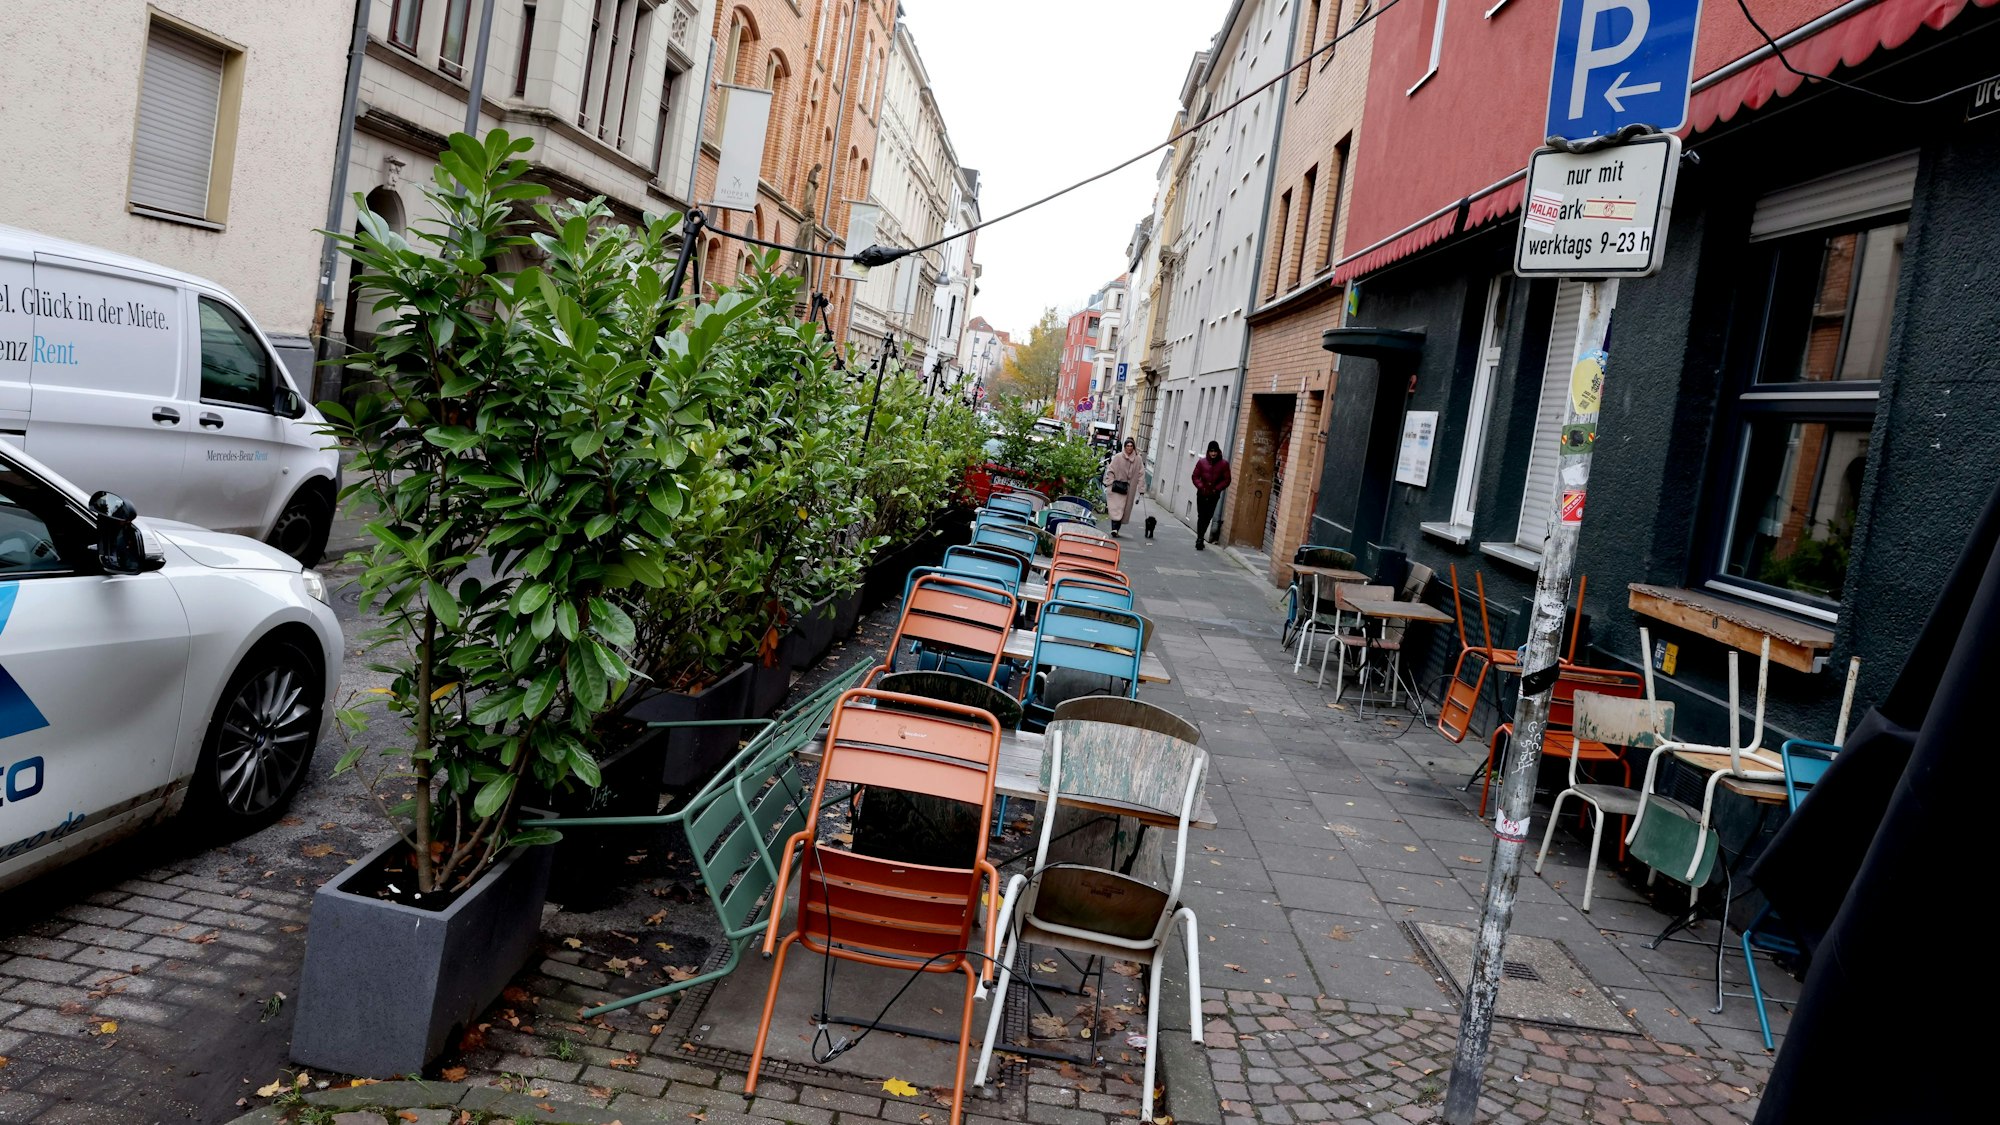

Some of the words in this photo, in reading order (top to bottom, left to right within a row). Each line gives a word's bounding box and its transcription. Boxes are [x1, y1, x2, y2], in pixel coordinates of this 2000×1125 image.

[1568, 0, 1651, 120] P
[1566, 167, 1592, 186] nur
[1598, 160, 1624, 183] mit
[1529, 202, 1559, 218] MALAD
[1529, 233, 1593, 260] werktags
[1640, 231, 1650, 252] h
[21, 287, 74, 320] Glück
[77, 295, 94, 322] in
[98, 297, 124, 325] der
[127, 301, 169, 330] Miete.
[33, 335, 78, 365] Rent.
[206, 449, 254, 462] Mercedes-Benz
